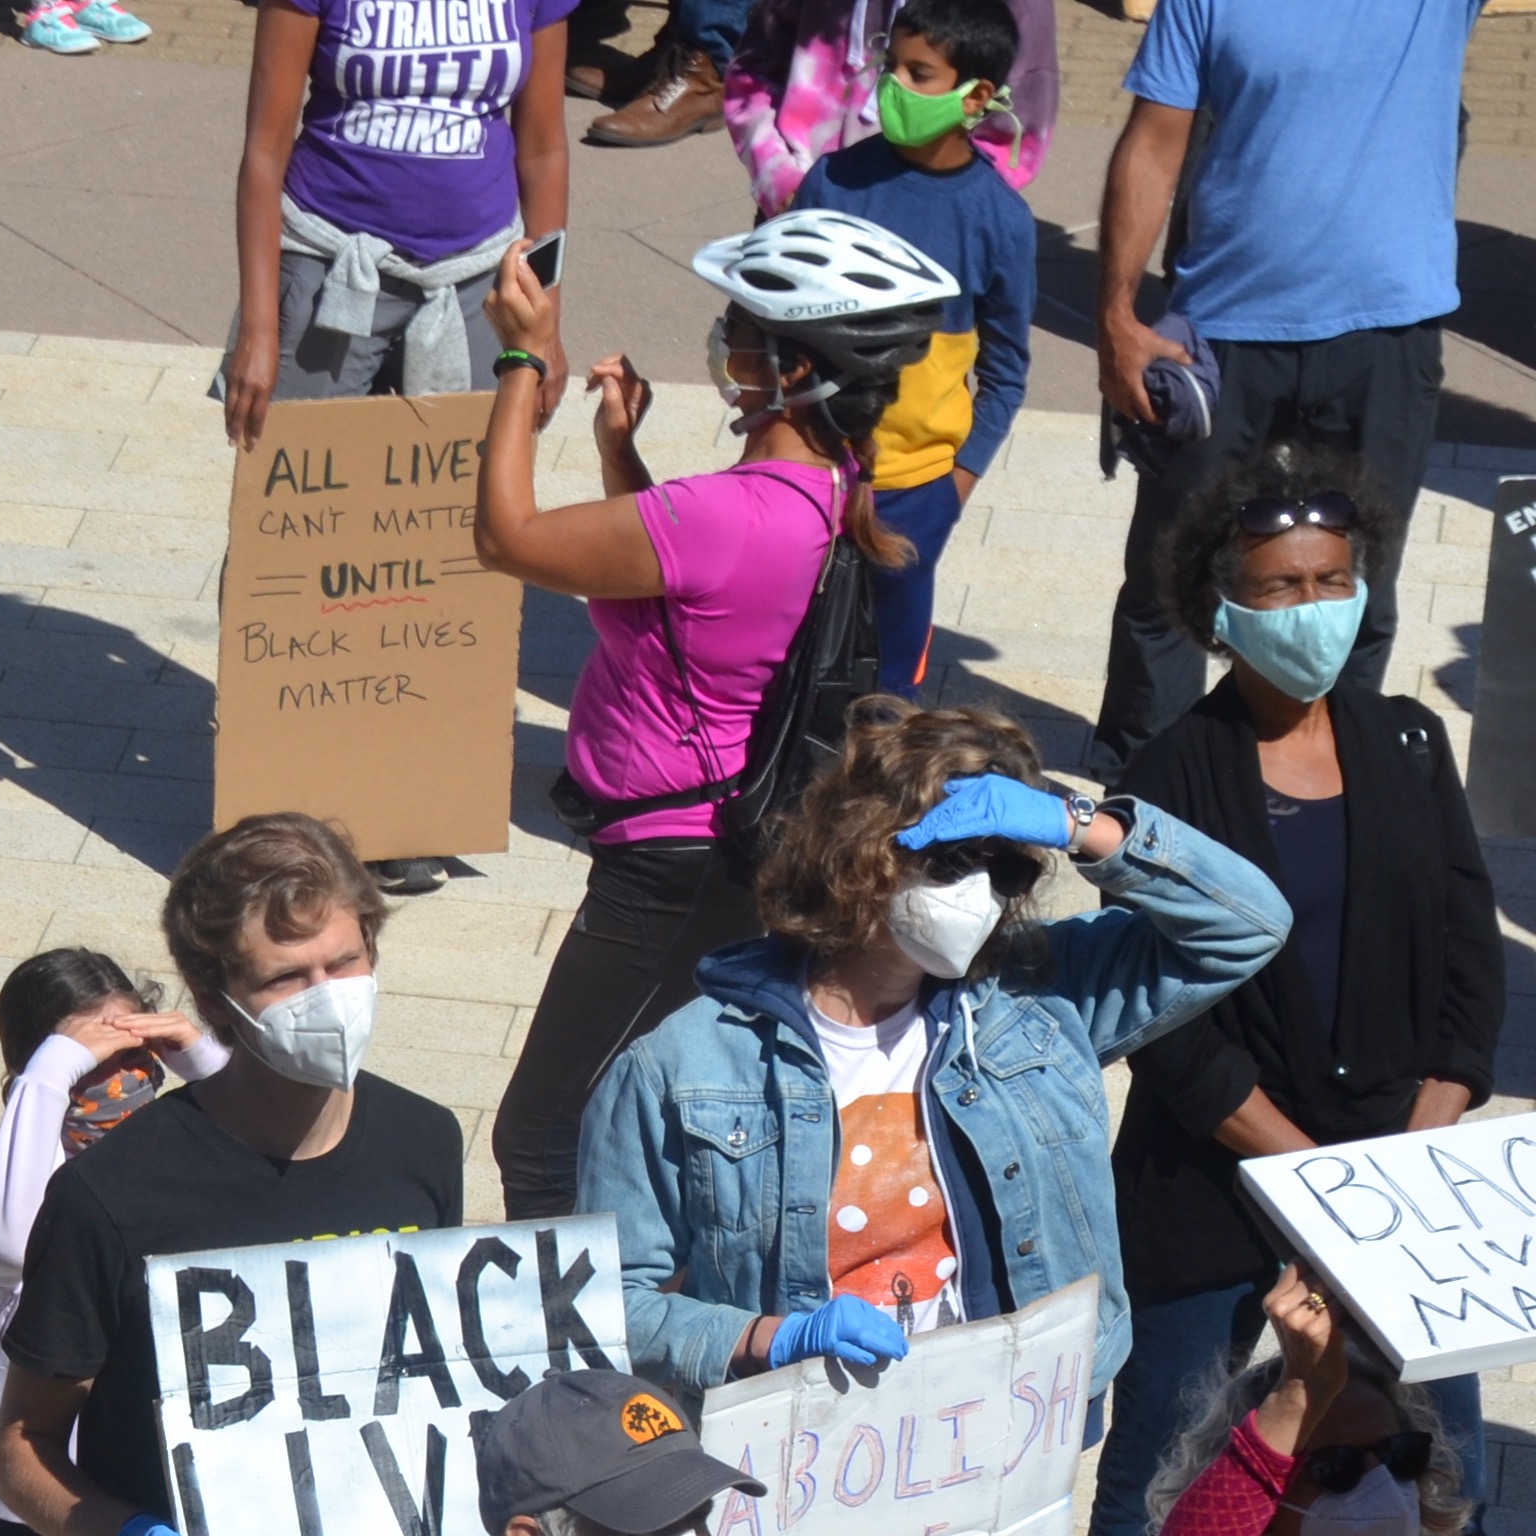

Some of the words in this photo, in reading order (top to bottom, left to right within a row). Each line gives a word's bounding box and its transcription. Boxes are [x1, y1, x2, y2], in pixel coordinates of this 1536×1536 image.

[351, 0, 508, 47] STRAIGHT
[344, 48, 511, 115] OUTTA
[343, 100, 483, 153] ORINDA
[808, 299, 860, 316] GIRO
[264, 447, 349, 497] ALL
[373, 505, 477, 536] MATTE
[321, 559, 436, 599] UNTIL
[237, 622, 352, 663] BLACK
[381, 620, 478, 650] LIVES
[279, 674, 427, 711] MATTER
[1291, 1136, 1536, 1245] BLAC
[1400, 1234, 1533, 1285] LIV
[175, 1228, 618, 1430] BLACK
